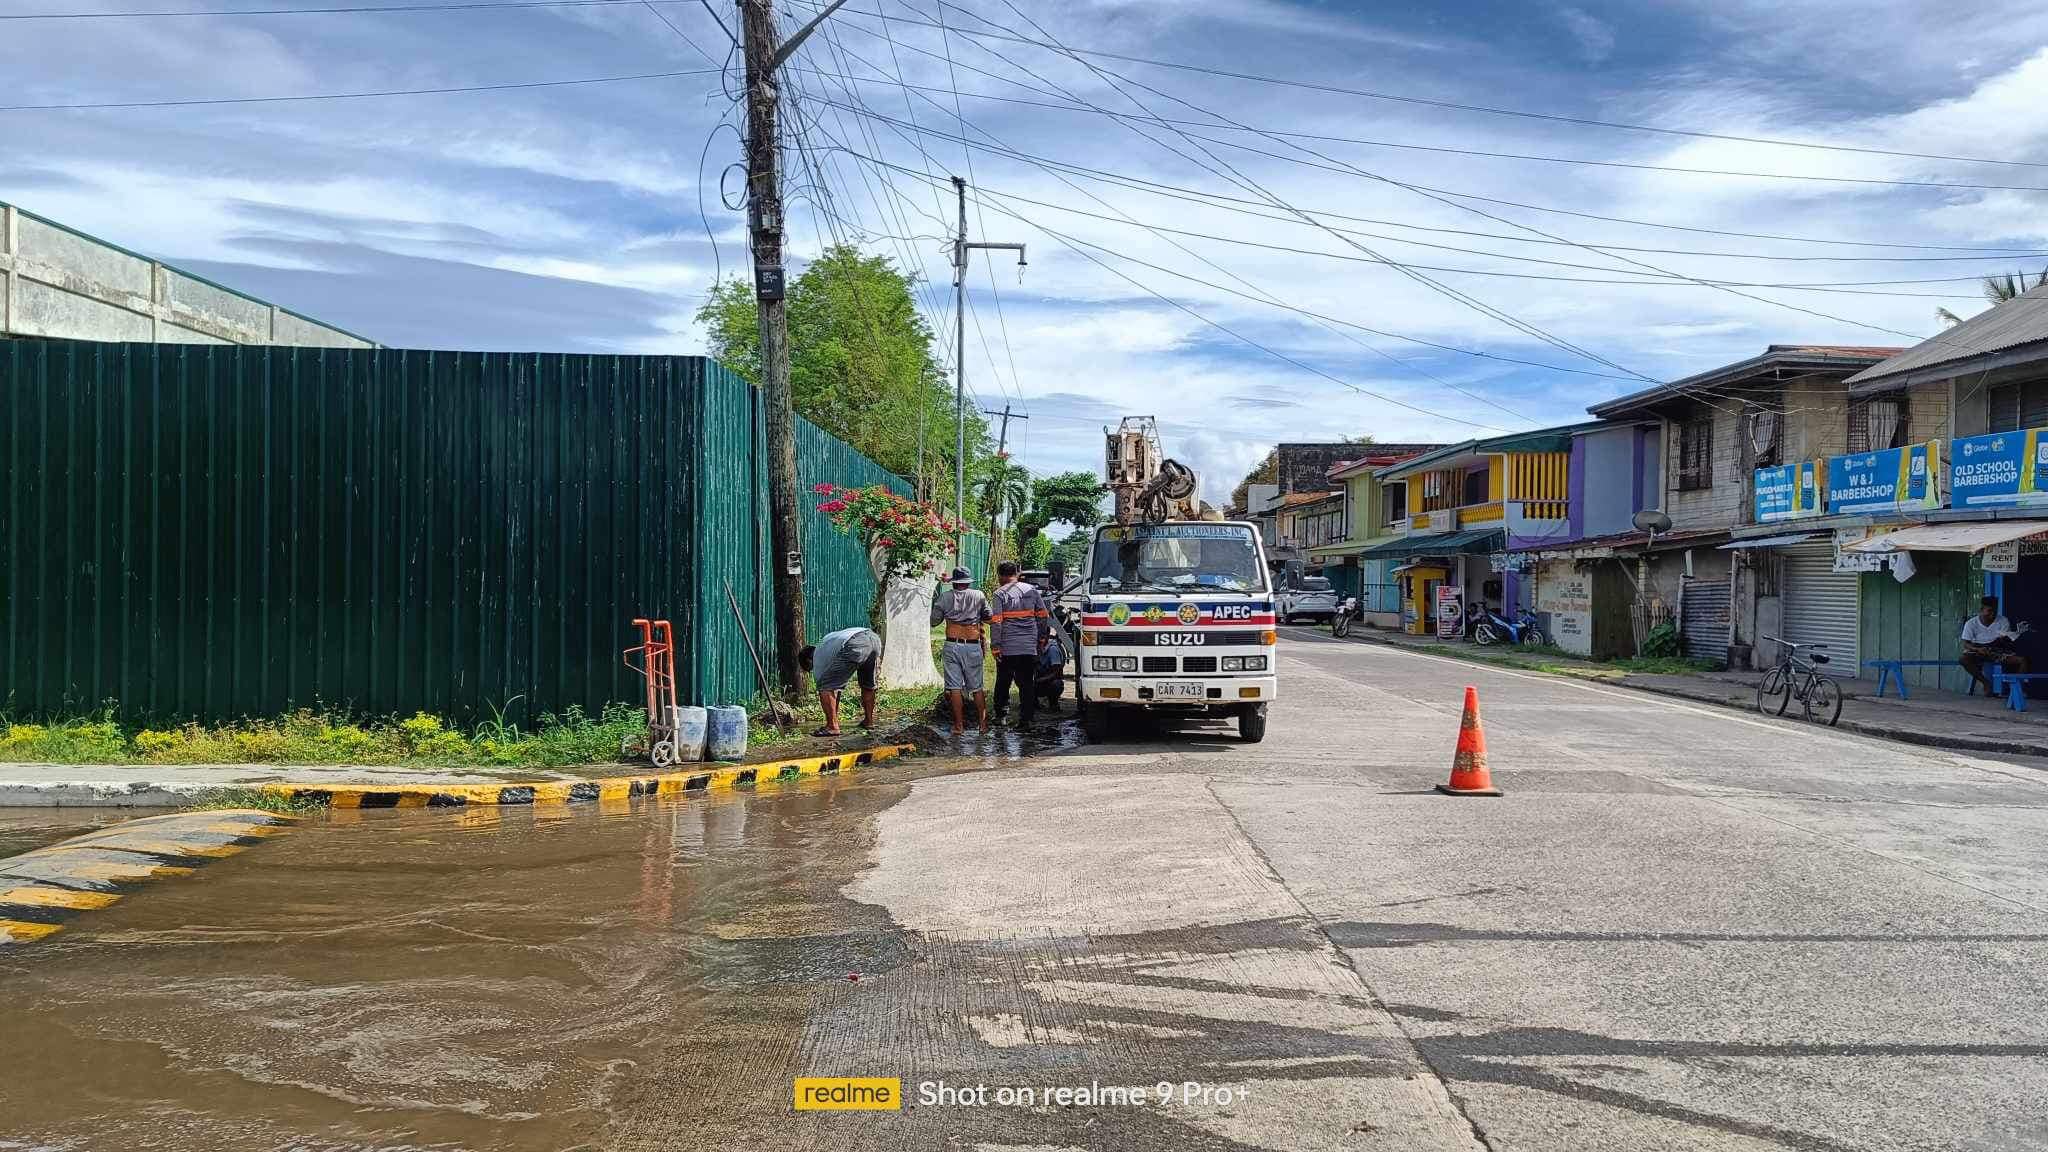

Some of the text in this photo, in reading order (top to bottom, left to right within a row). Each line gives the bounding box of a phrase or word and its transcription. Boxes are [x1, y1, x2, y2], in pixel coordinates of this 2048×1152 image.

[1955, 460, 2017, 477] OLD SCHOOL
[1849, 472, 1874, 487] W & J
[1953, 472, 2018, 488] BARBERSHOP
[1831, 484, 1894, 501] BARBERSHOP
[1991, 554, 2015, 562] RENT
[1213, 605, 1251, 619] APEC
[1154, 633, 1205, 645] ISUZU
[1158, 685, 1202, 695] CAR 7413
